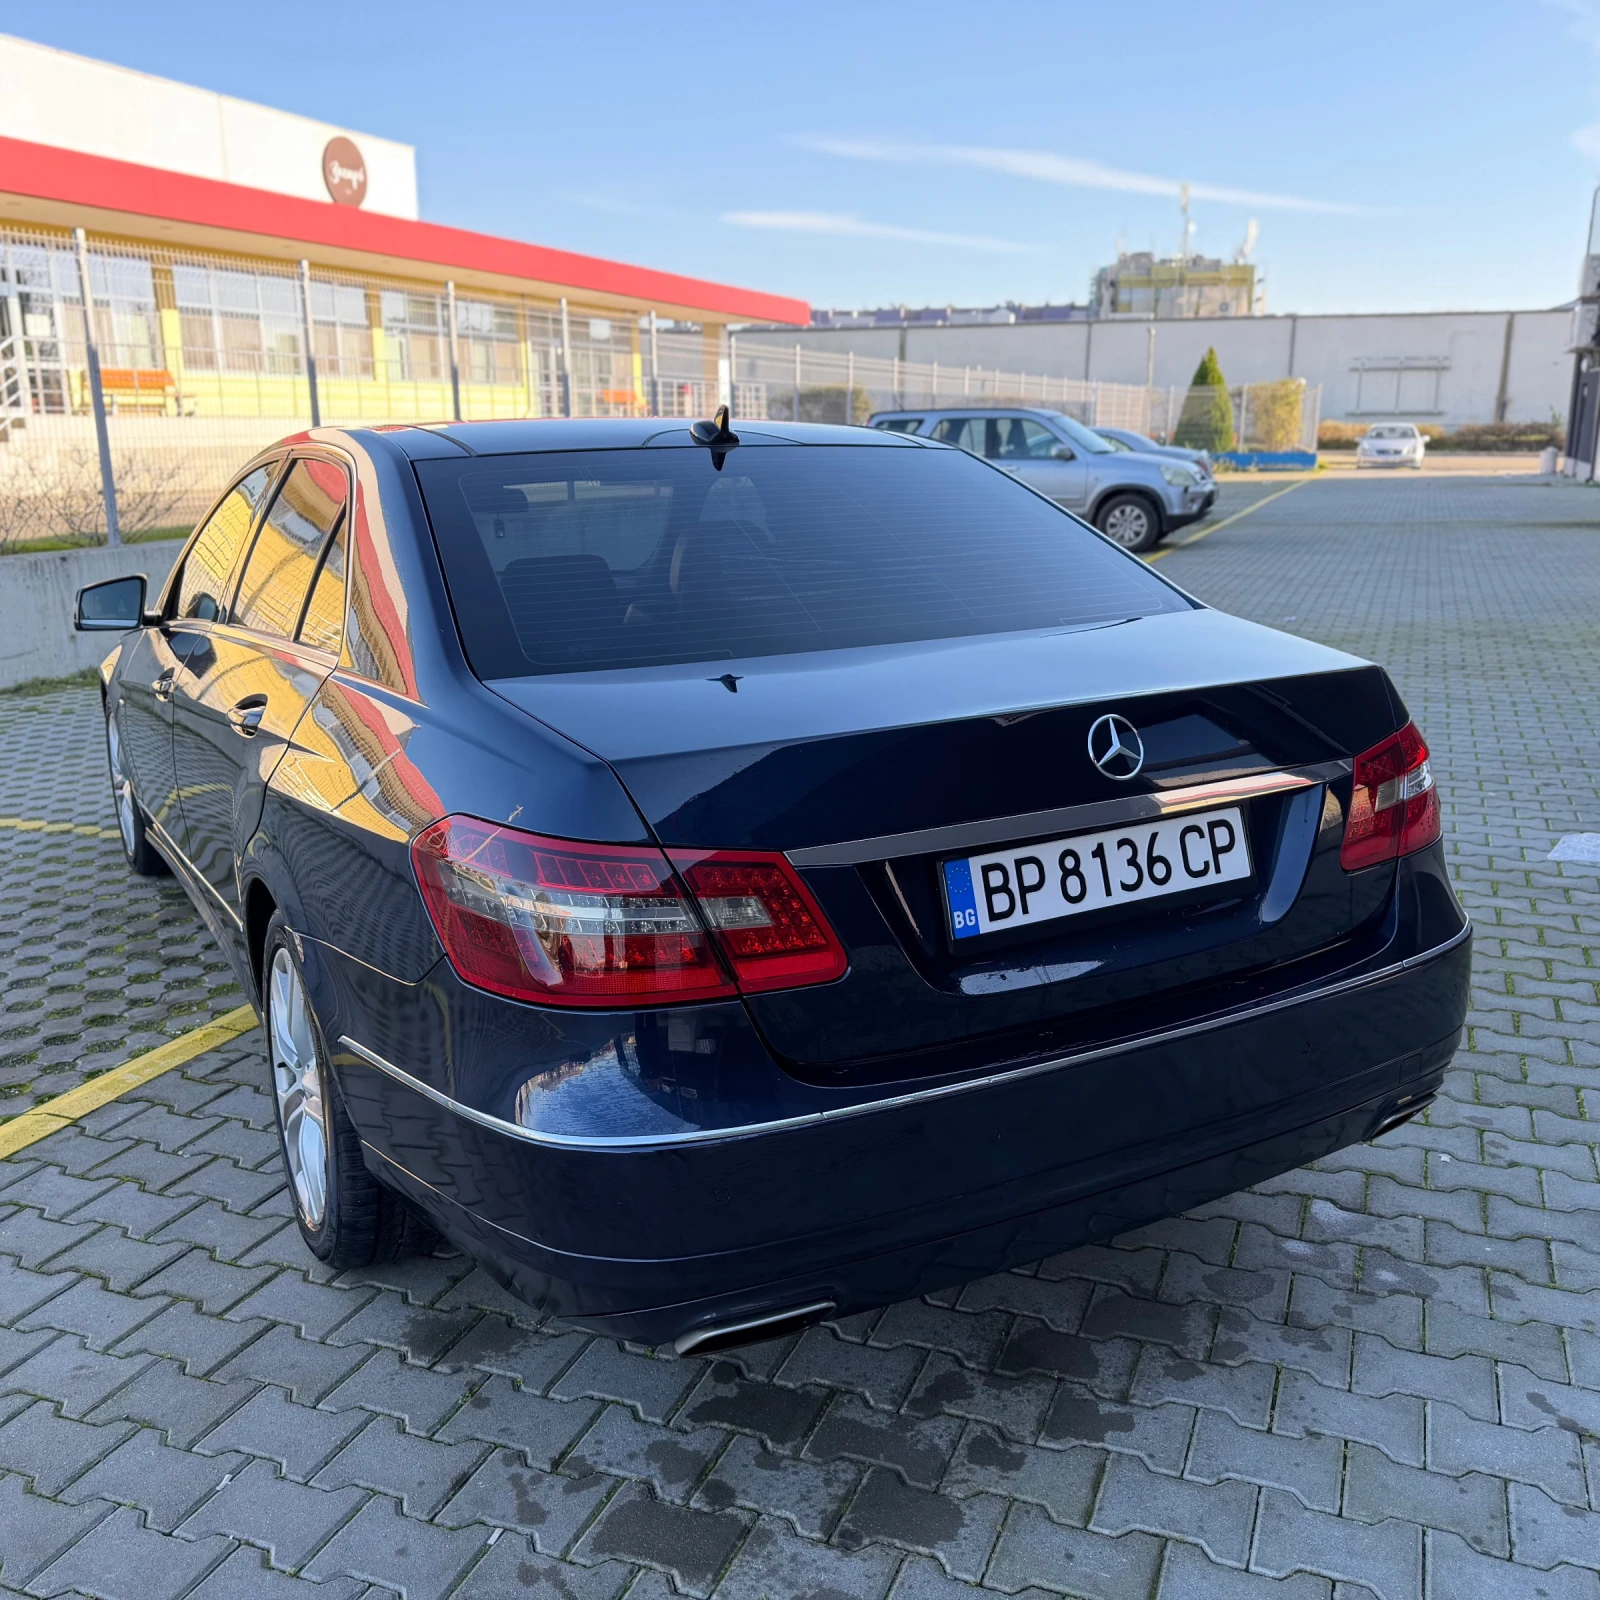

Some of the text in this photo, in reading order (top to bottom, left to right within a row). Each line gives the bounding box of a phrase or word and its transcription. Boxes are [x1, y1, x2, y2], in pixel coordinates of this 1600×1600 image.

[980, 818, 1236, 922] BP 8136 CP
[953, 909, 976, 929] BG
